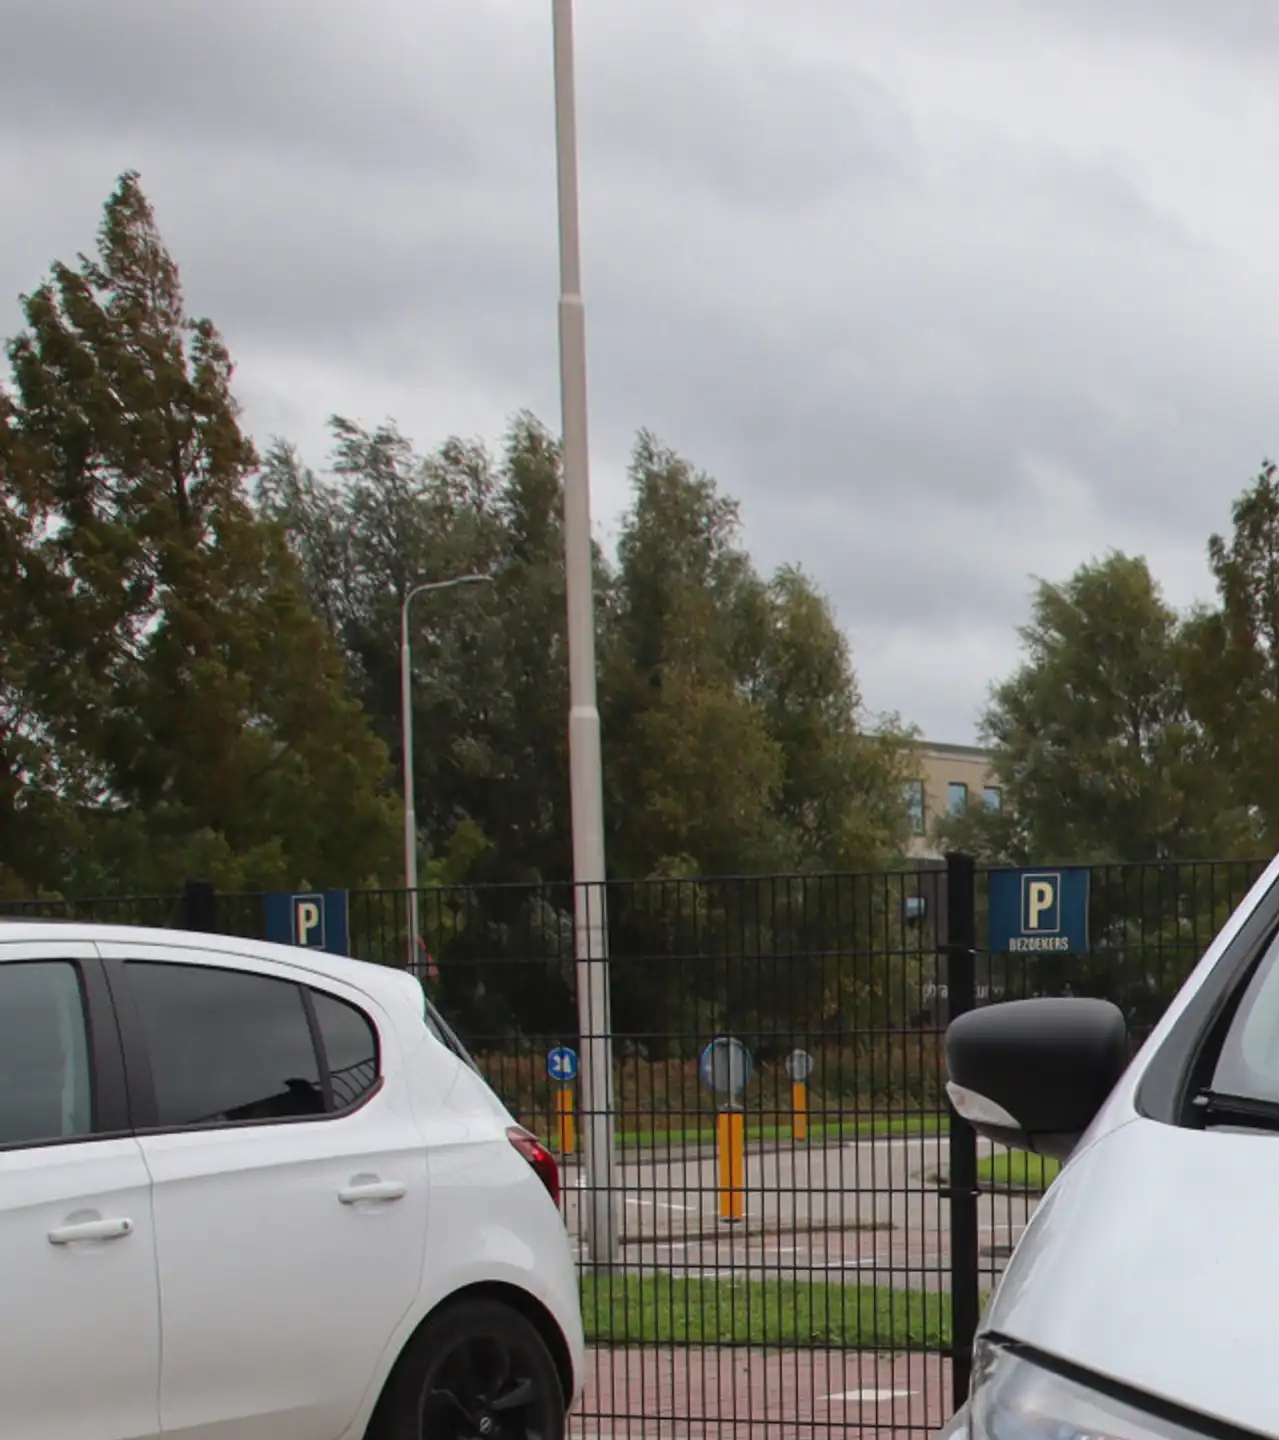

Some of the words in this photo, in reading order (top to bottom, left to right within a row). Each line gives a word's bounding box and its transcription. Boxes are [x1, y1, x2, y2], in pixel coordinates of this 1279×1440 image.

[298, 903, 319, 945] P
[1029, 881, 1053, 929] P
[1009, 937, 1068, 952] BEZOEKERS
